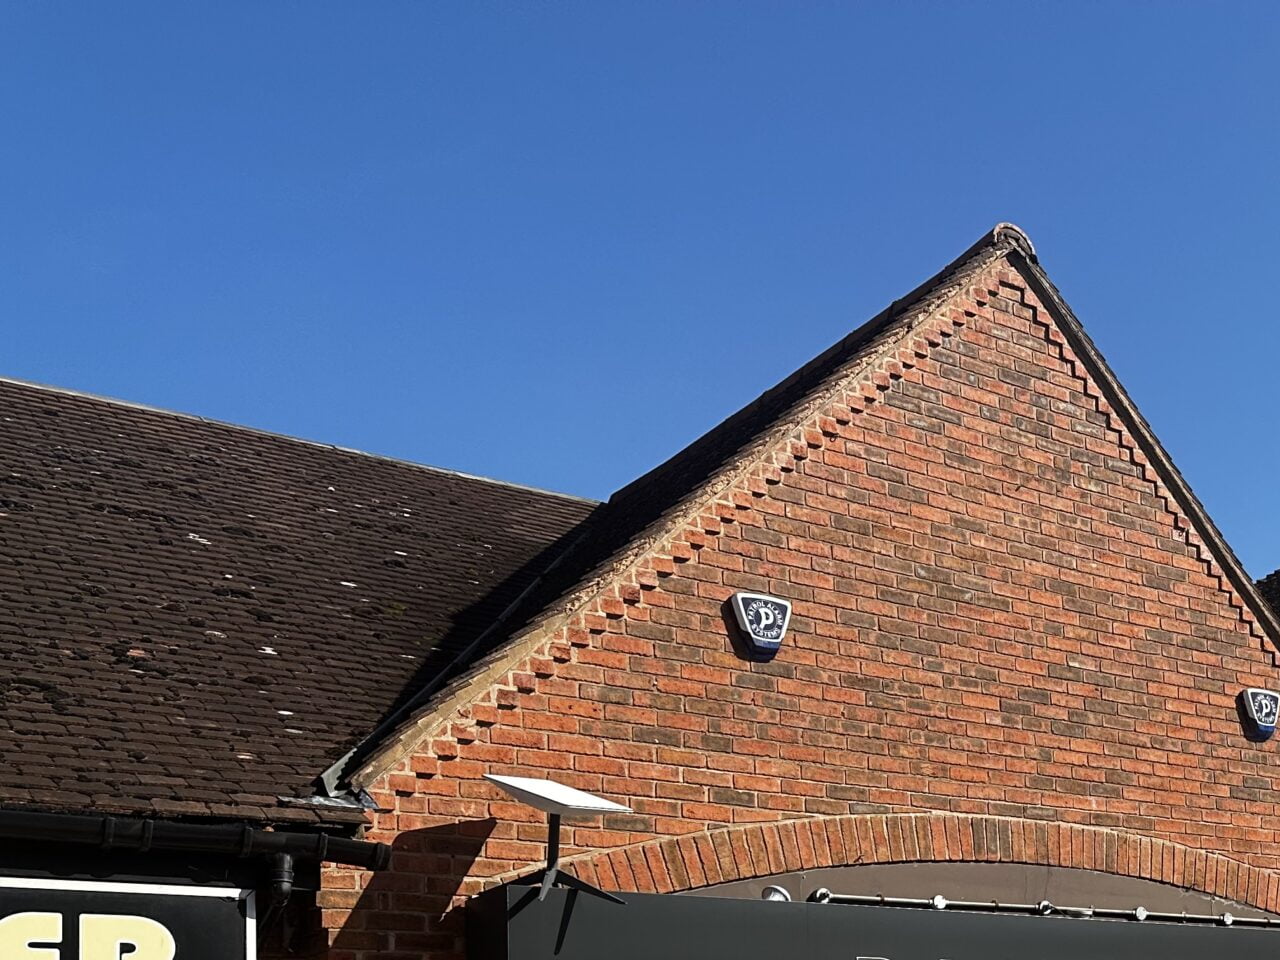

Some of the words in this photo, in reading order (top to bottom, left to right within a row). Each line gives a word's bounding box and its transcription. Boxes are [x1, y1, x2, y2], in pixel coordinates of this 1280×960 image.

[747, 601, 766, 620] PATROL
[766, 603, 784, 626] ALARM
[751, 623, 781, 638] SYSTEMS
